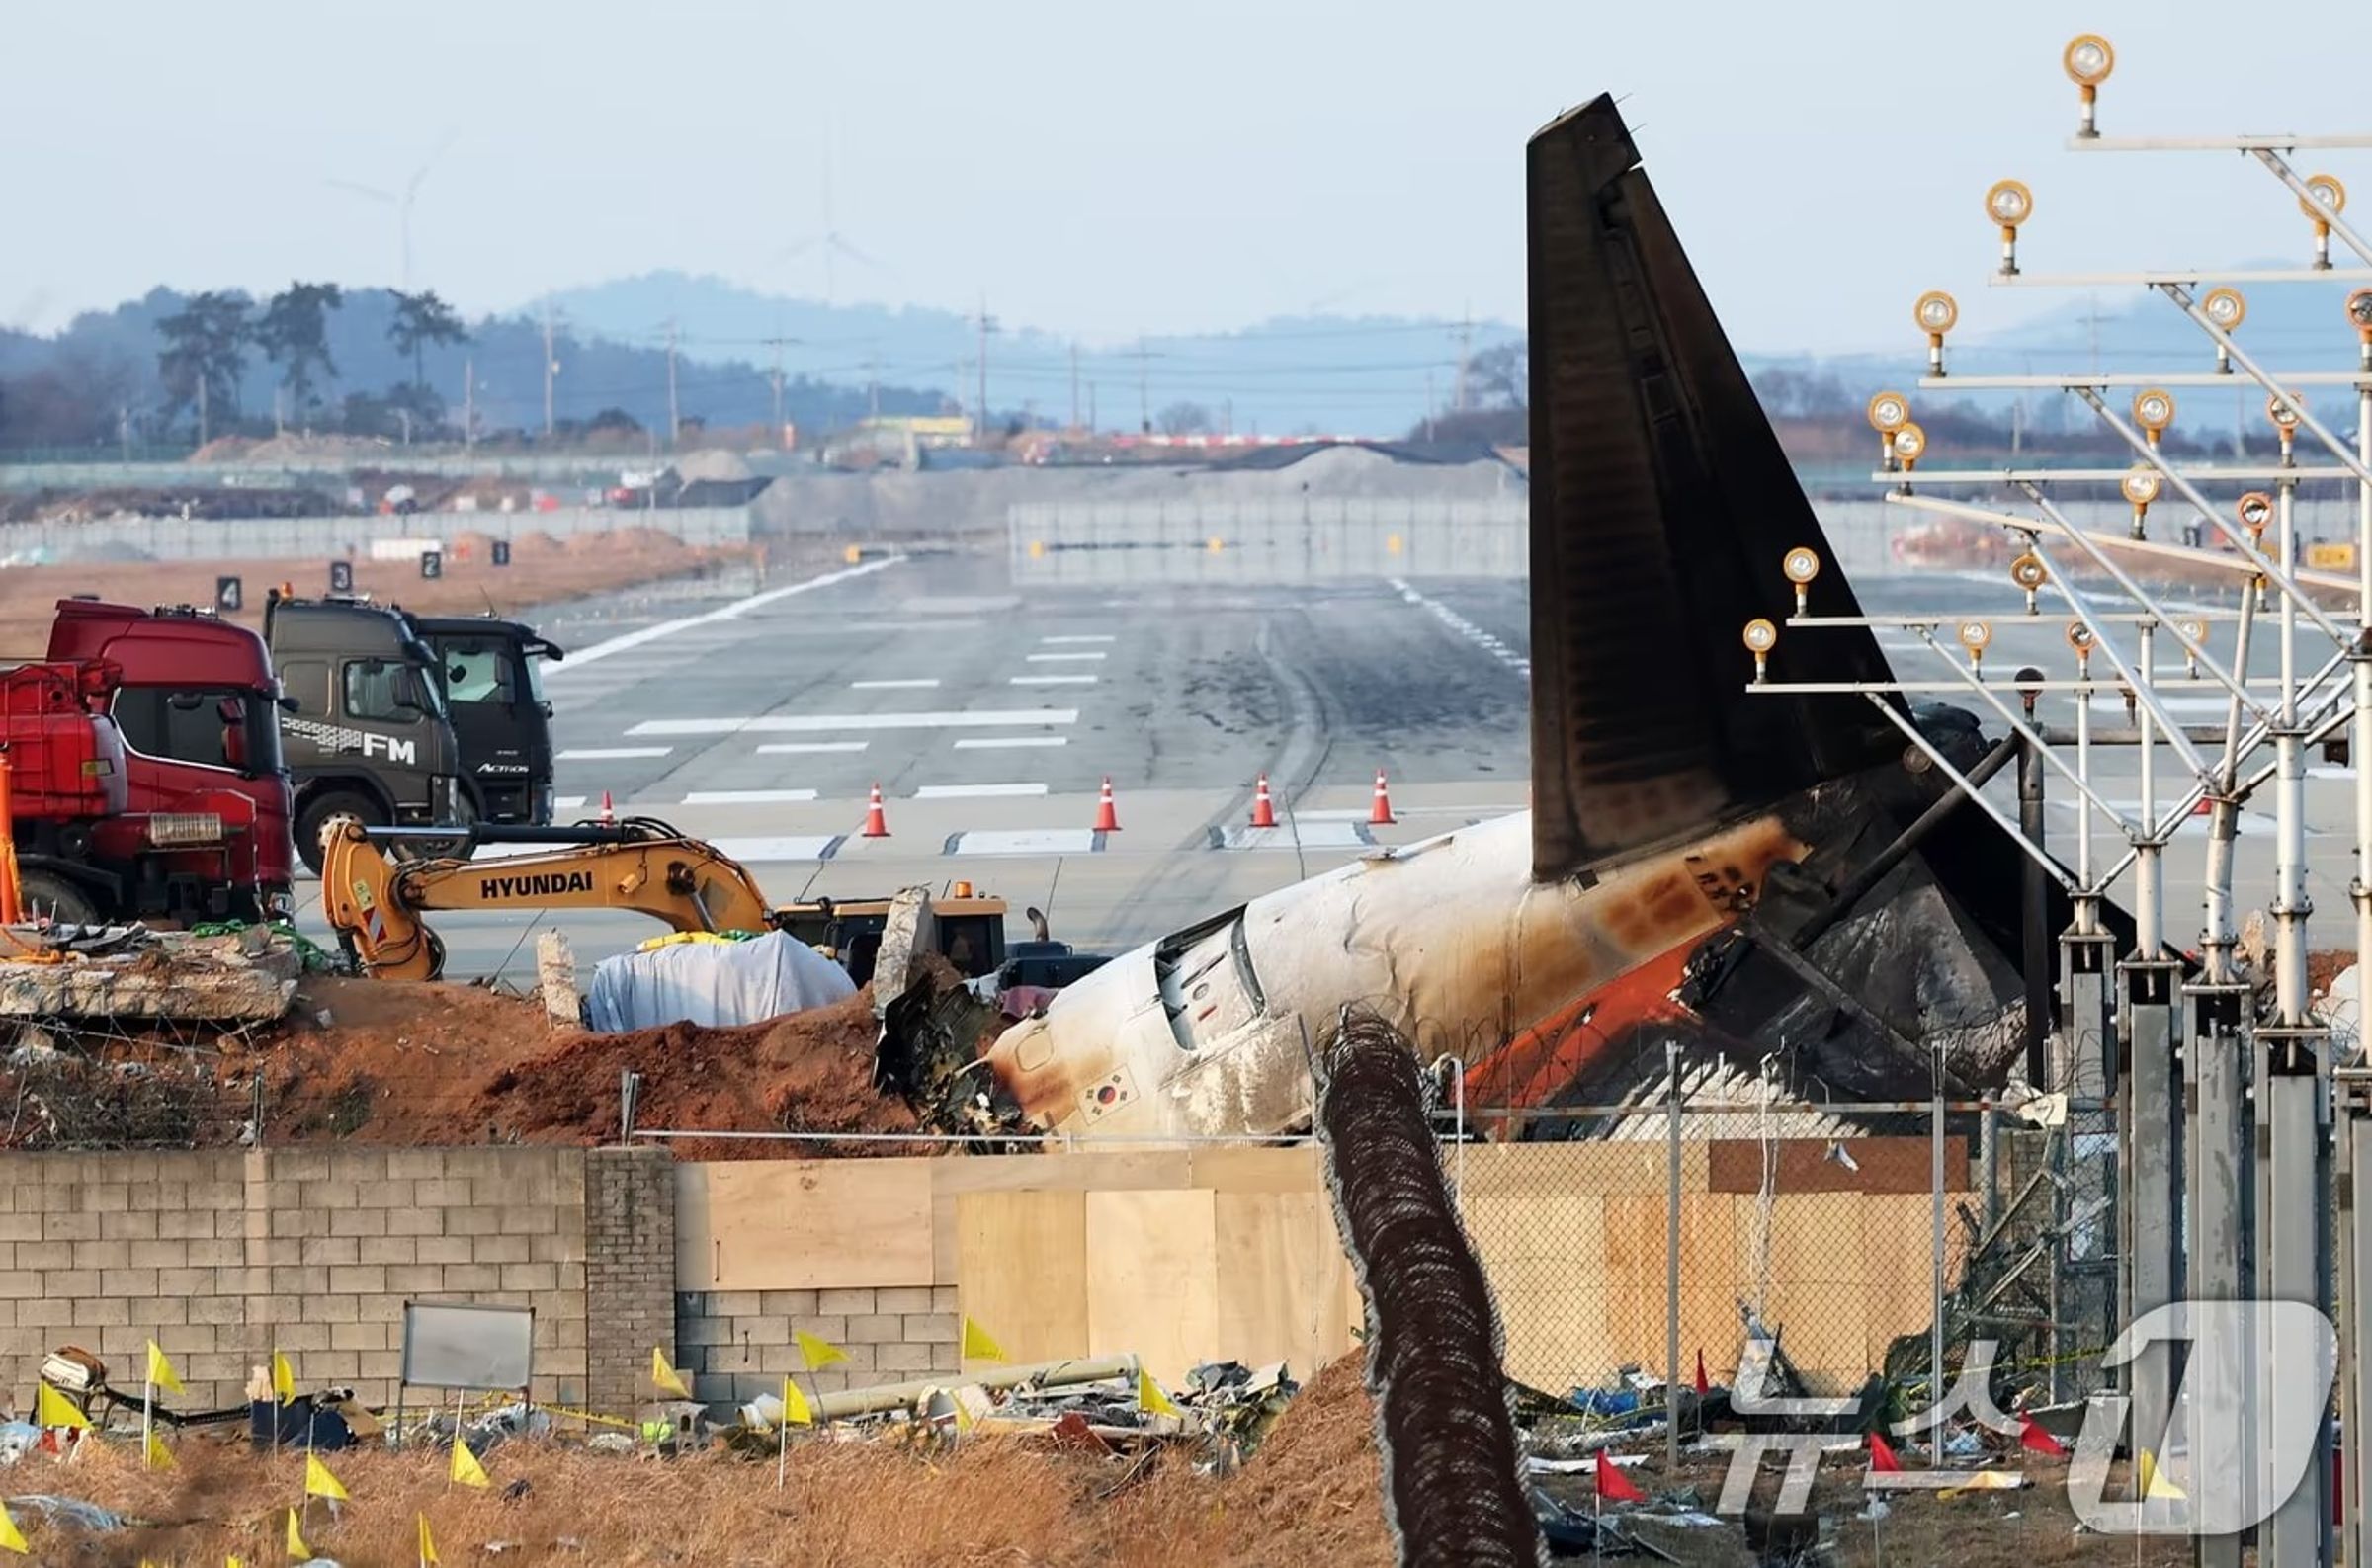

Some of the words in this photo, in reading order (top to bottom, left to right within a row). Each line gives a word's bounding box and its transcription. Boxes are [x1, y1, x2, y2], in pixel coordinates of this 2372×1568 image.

[334, 566, 348, 589] 3
[425, 555, 439, 576] 2
[222, 581, 237, 608] 4
[363, 732, 415, 765] FM
[480, 871, 592, 899] HYUNDAI
